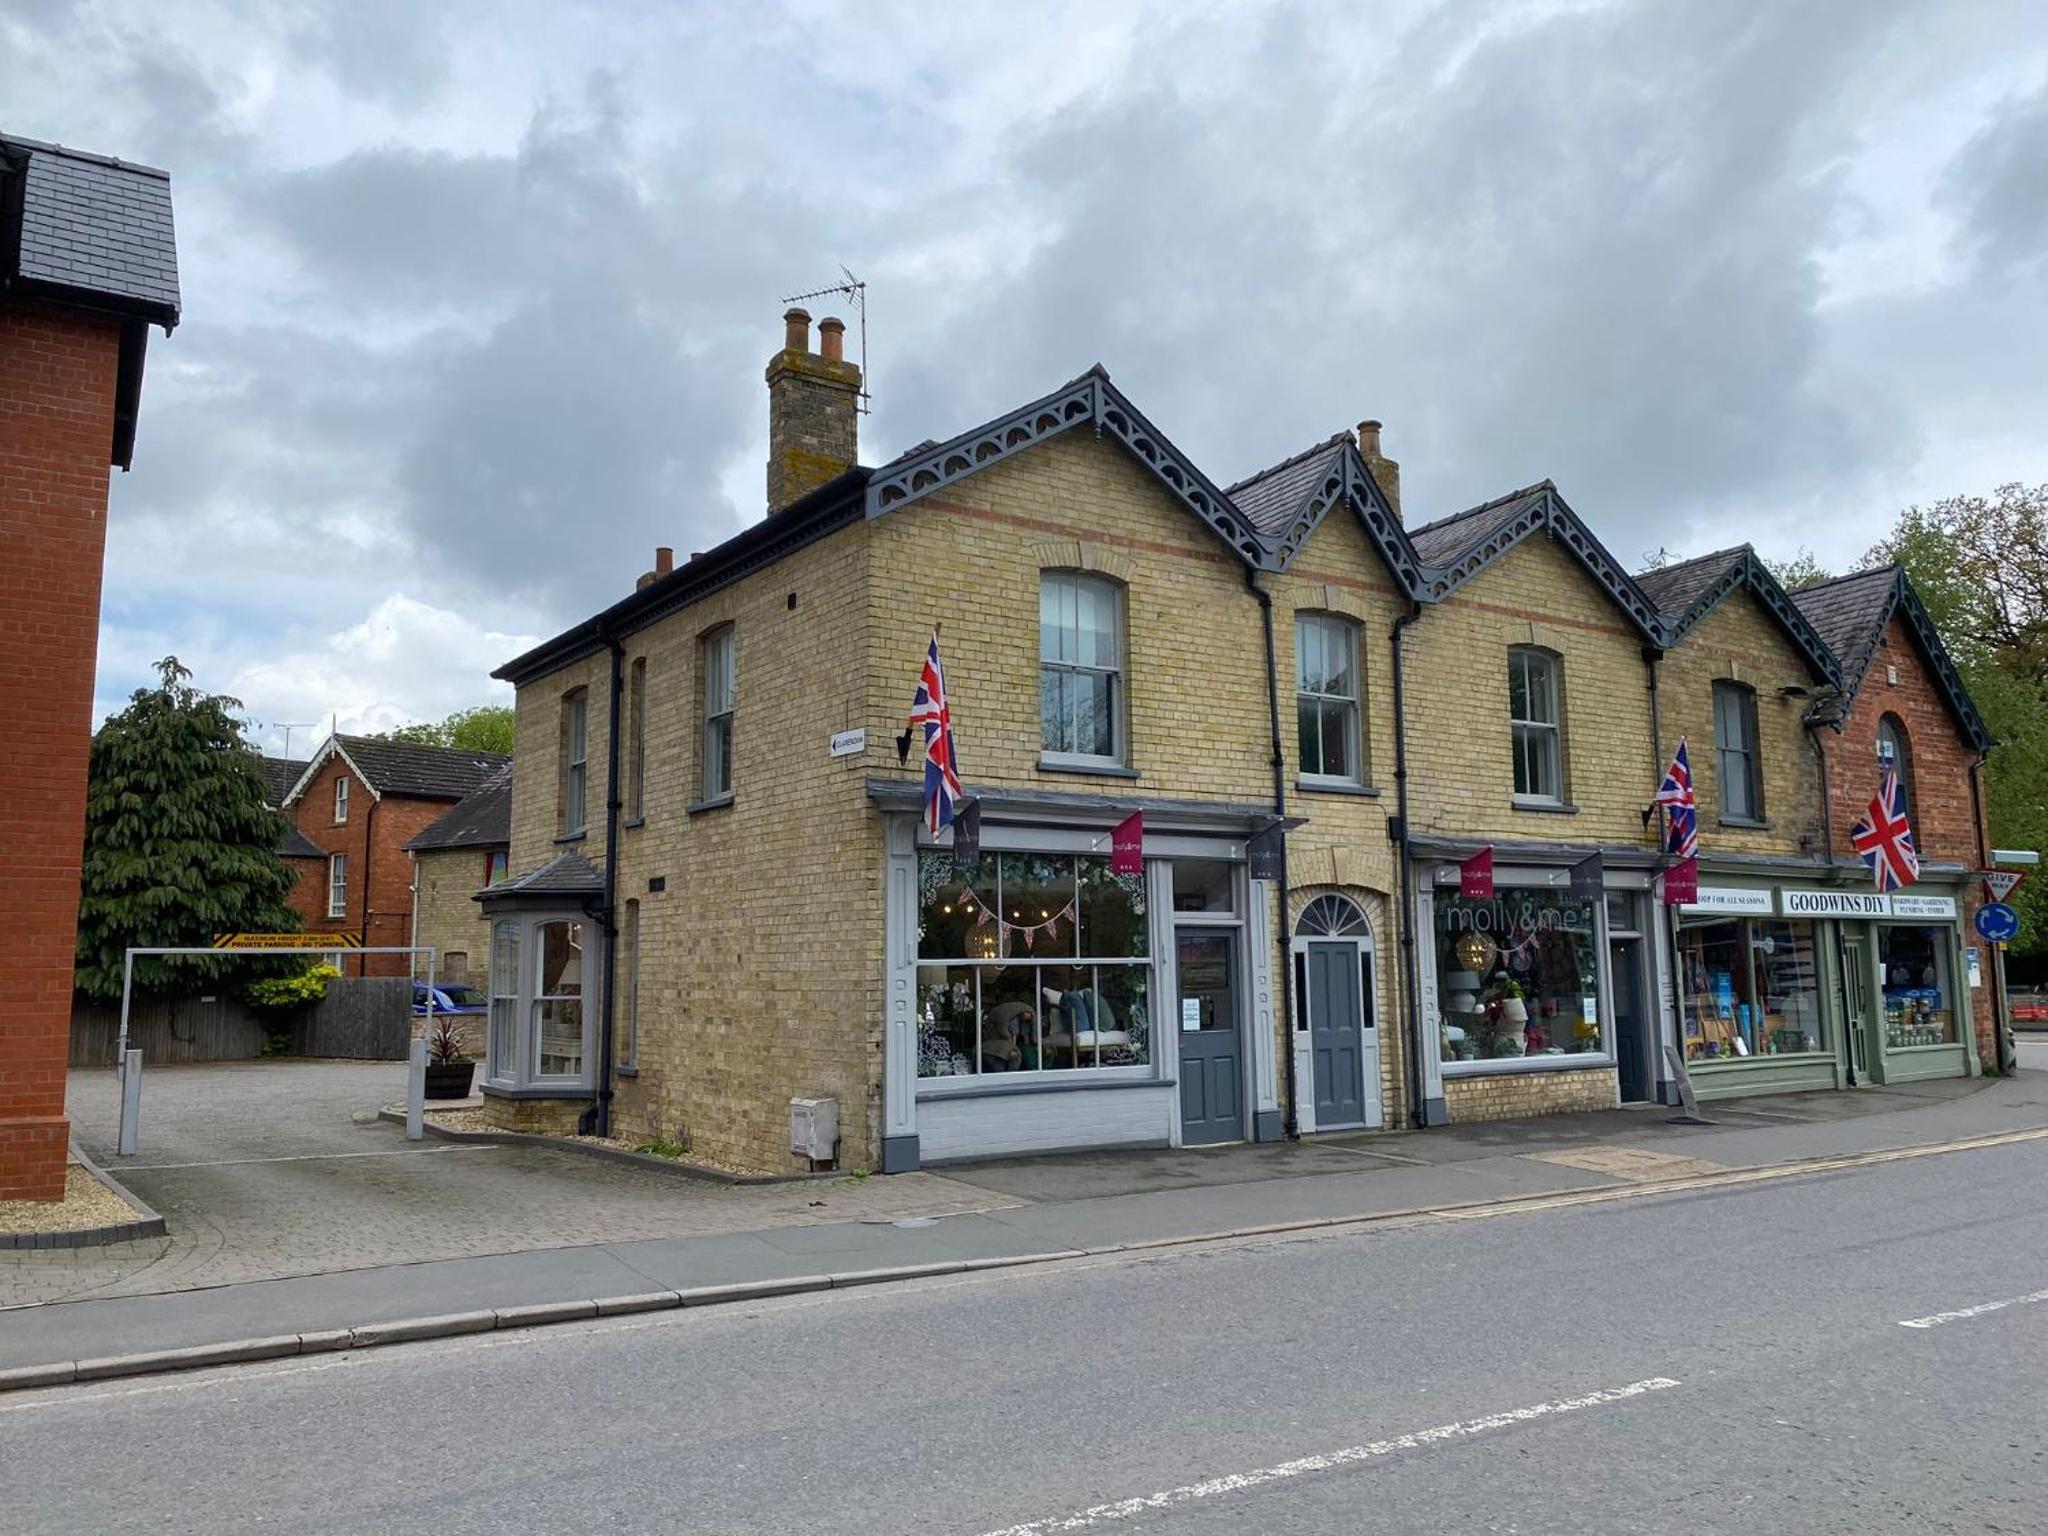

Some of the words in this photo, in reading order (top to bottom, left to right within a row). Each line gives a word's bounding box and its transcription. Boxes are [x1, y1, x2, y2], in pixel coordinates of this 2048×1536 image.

[1987, 872, 2016, 882] GIVE
[1790, 893, 1862, 913] GOODWINS
[1864, 896, 1885, 913] DIY
[1447, 899, 1578, 939] molly&me
